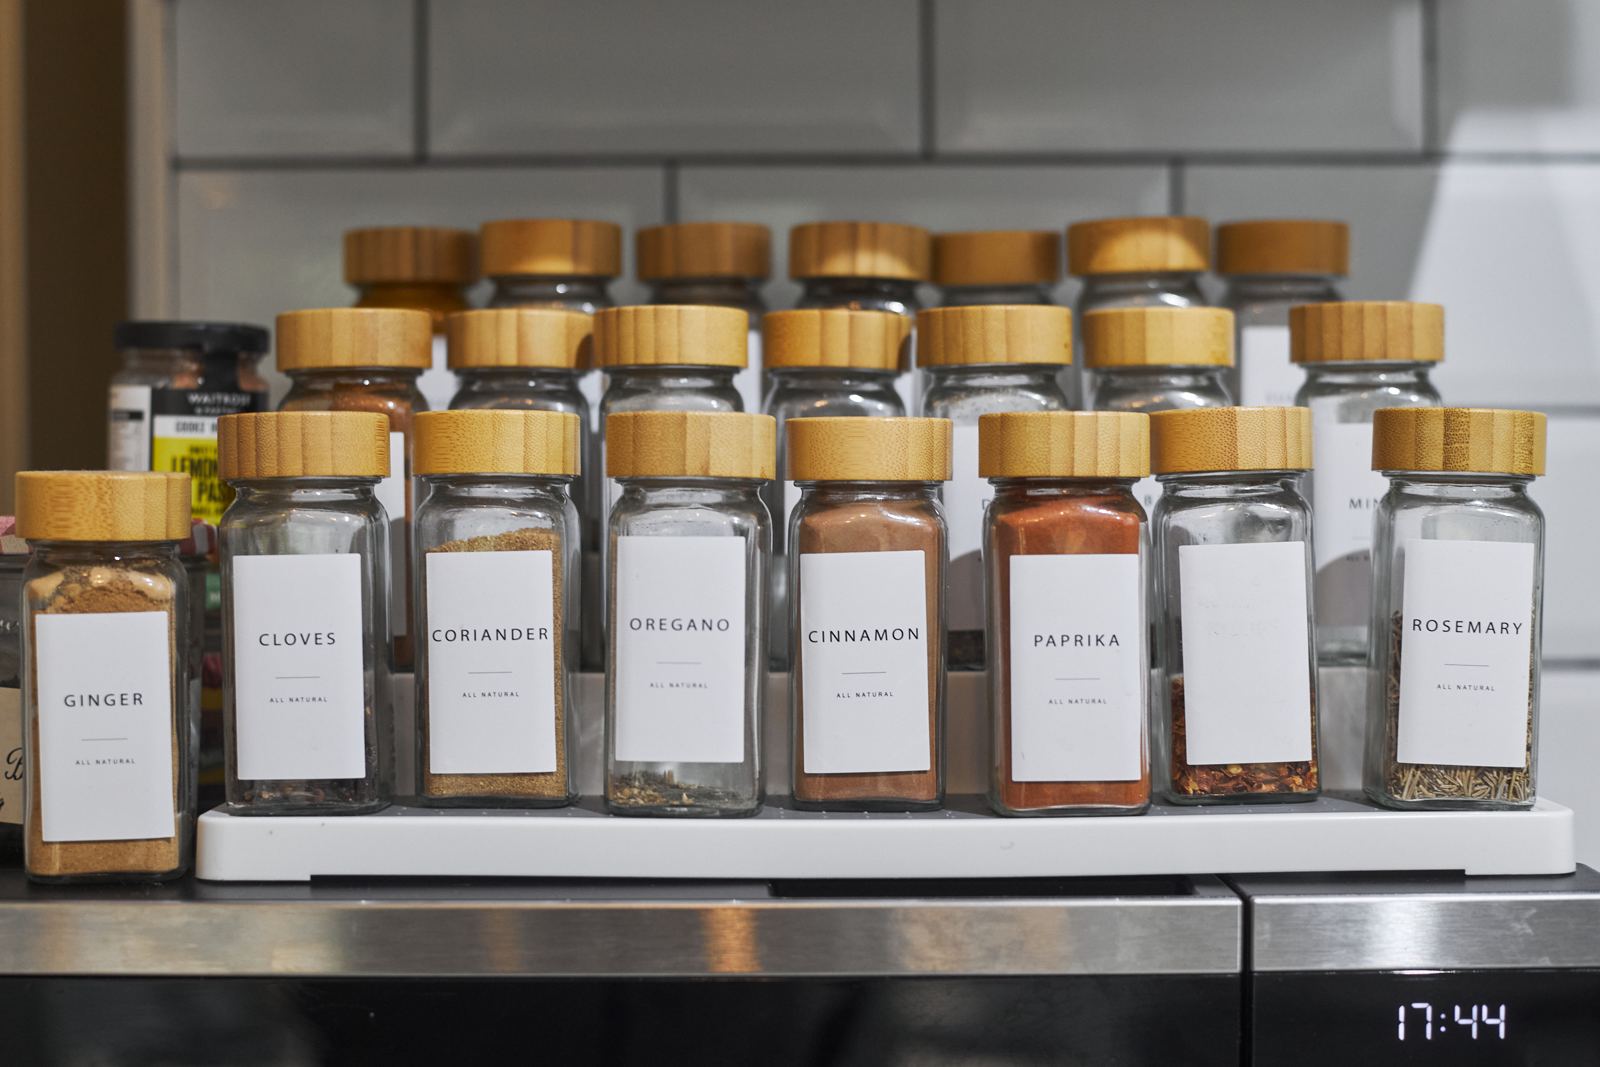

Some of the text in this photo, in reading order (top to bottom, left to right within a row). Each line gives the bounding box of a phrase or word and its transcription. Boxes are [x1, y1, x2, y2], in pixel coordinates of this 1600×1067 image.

[628, 617, 730, 632] OREGANO
[1411, 618, 1523, 636] ROSEMARY
[258, 631, 336, 647] CLOVES
[431, 627, 548, 643] CORIANDER
[807, 627, 919, 644] CINNAMON
[1033, 633, 1120, 648] PAPRIKA
[668, 682, 709, 690] NATURAL
[1456, 684, 1495, 692] NATURAL
[63, 692, 144, 708] GINGER
[462, 691, 477, 699] ALL
[95, 758, 136, 766] NATURAL
[1398, 1002, 1506, 1041] 17:44
